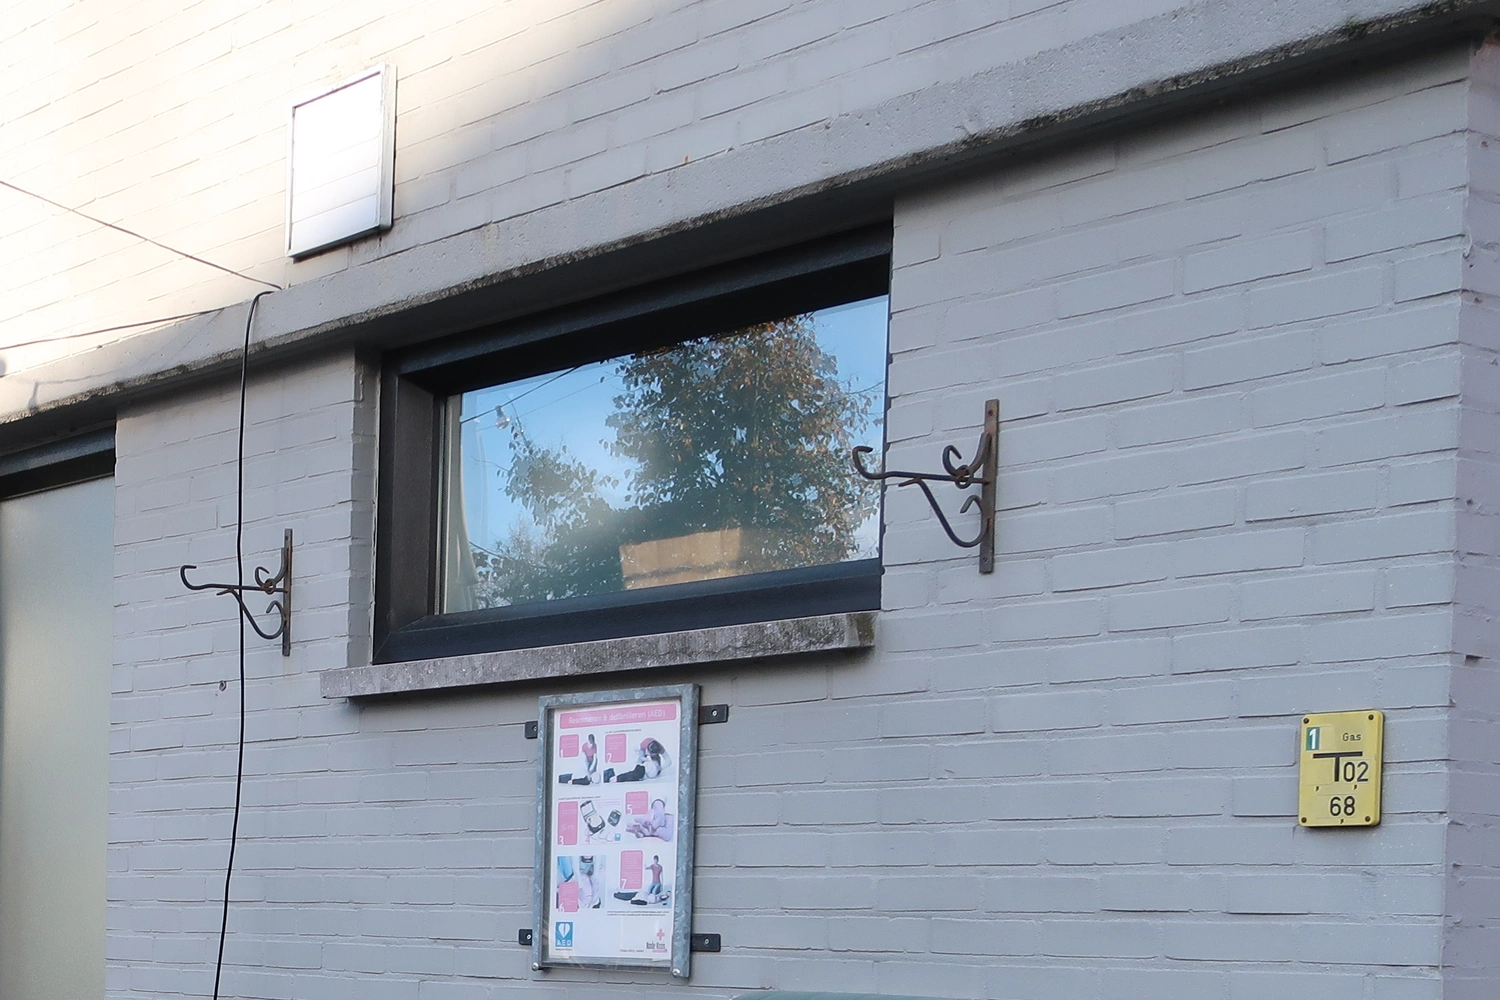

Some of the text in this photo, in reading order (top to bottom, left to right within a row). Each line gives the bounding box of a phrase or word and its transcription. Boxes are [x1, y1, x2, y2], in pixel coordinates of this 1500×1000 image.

[609, 710, 646, 721] defibrilleren
[647, 708, 666, 718] (AED)
[1309, 728, 1362, 749] 1 Gas
[607, 752, 612, 763] 2
[1343, 761, 1369, 782] 02
[627, 804, 633, 814] 5
[1330, 796, 1356, 816] 68
[621, 879, 627, 889] 7
